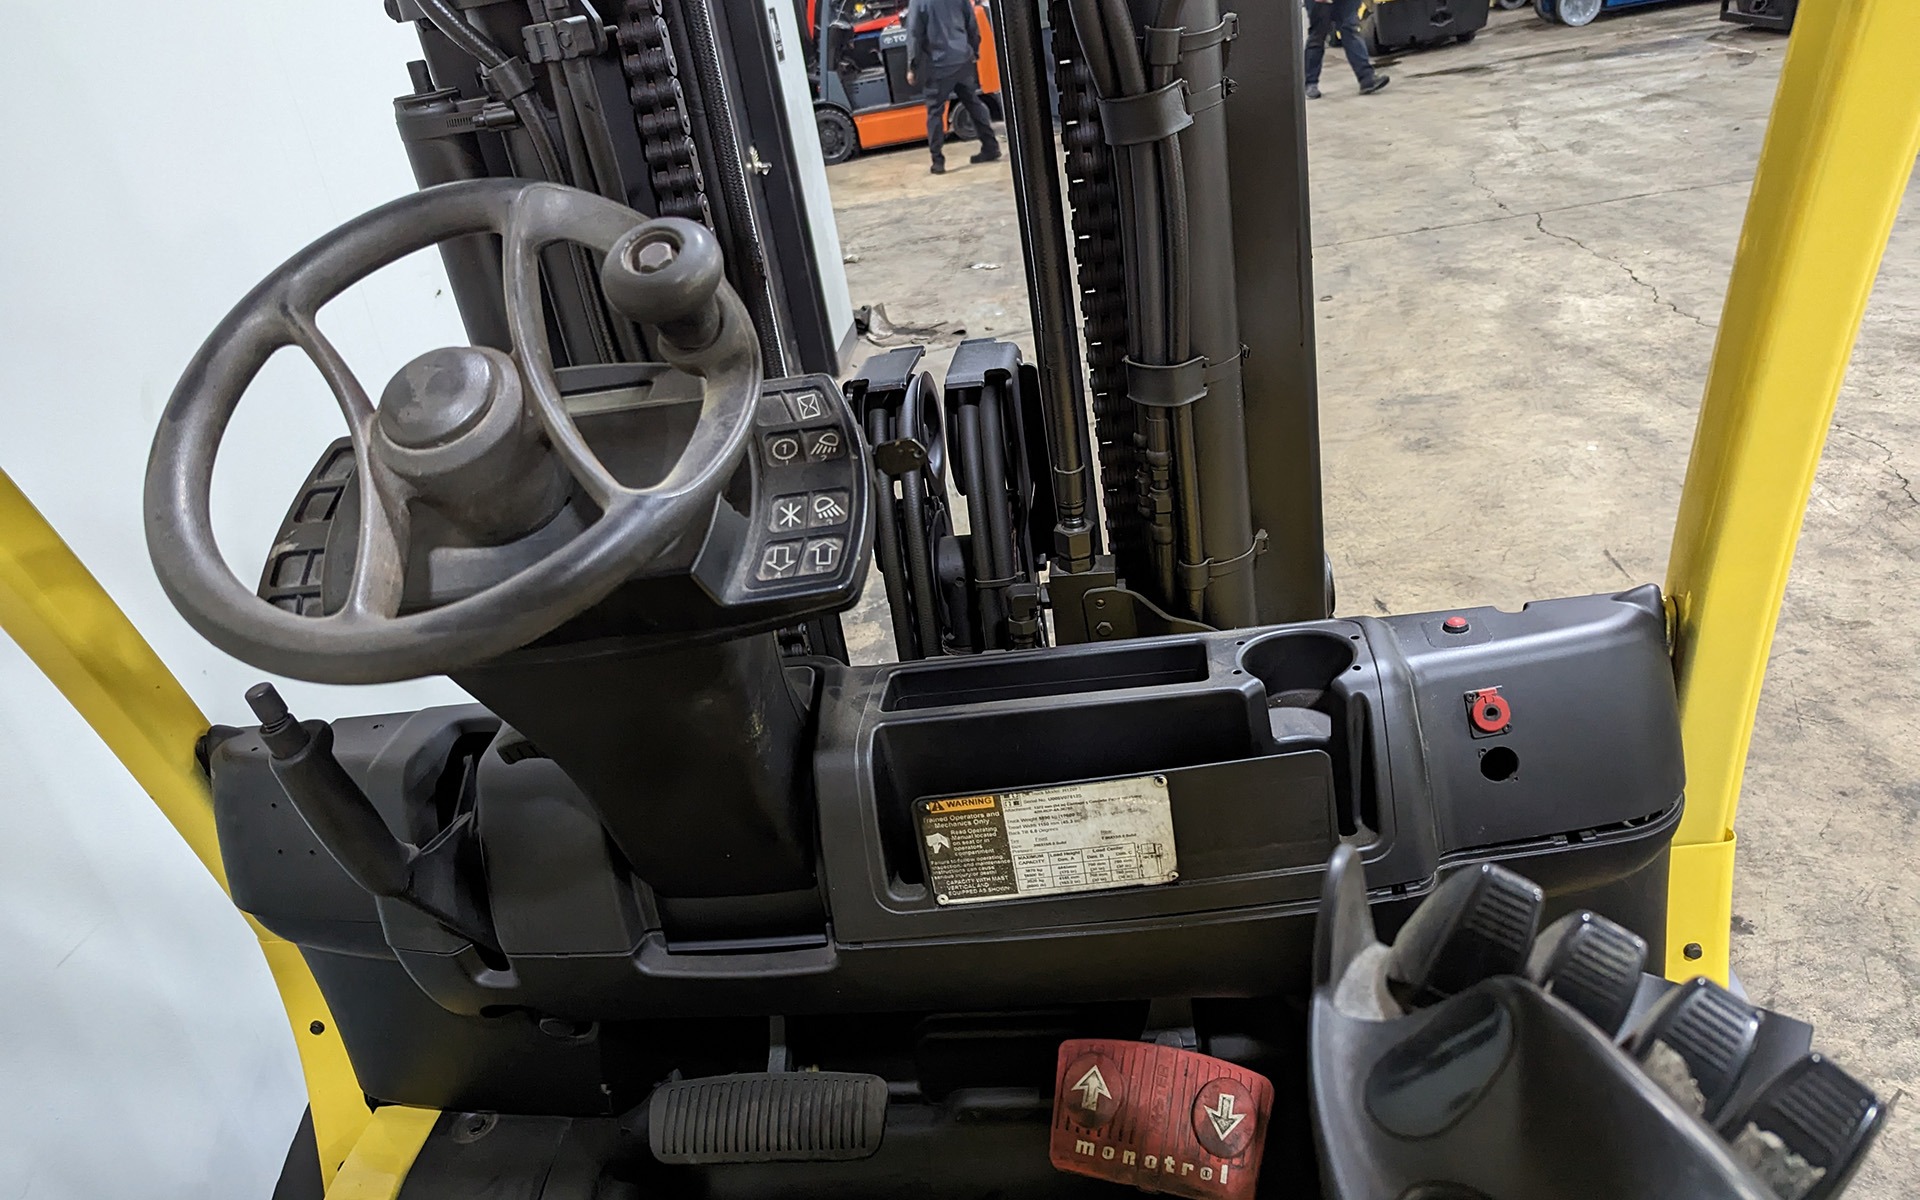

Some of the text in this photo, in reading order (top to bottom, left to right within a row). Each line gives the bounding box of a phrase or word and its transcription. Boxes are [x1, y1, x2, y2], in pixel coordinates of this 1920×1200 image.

[946, 798, 992, 808] WARNING
[950, 813, 985, 821] Operators
[934, 820, 972, 829] Mechanics
[968, 826, 998, 835] Operating
[955, 848, 995, 857] compartment
[975, 859, 1010, 867] maintenance
[946, 878, 975, 886] CAPACITY
[1075, 1139, 1229, 1184] monotrol
